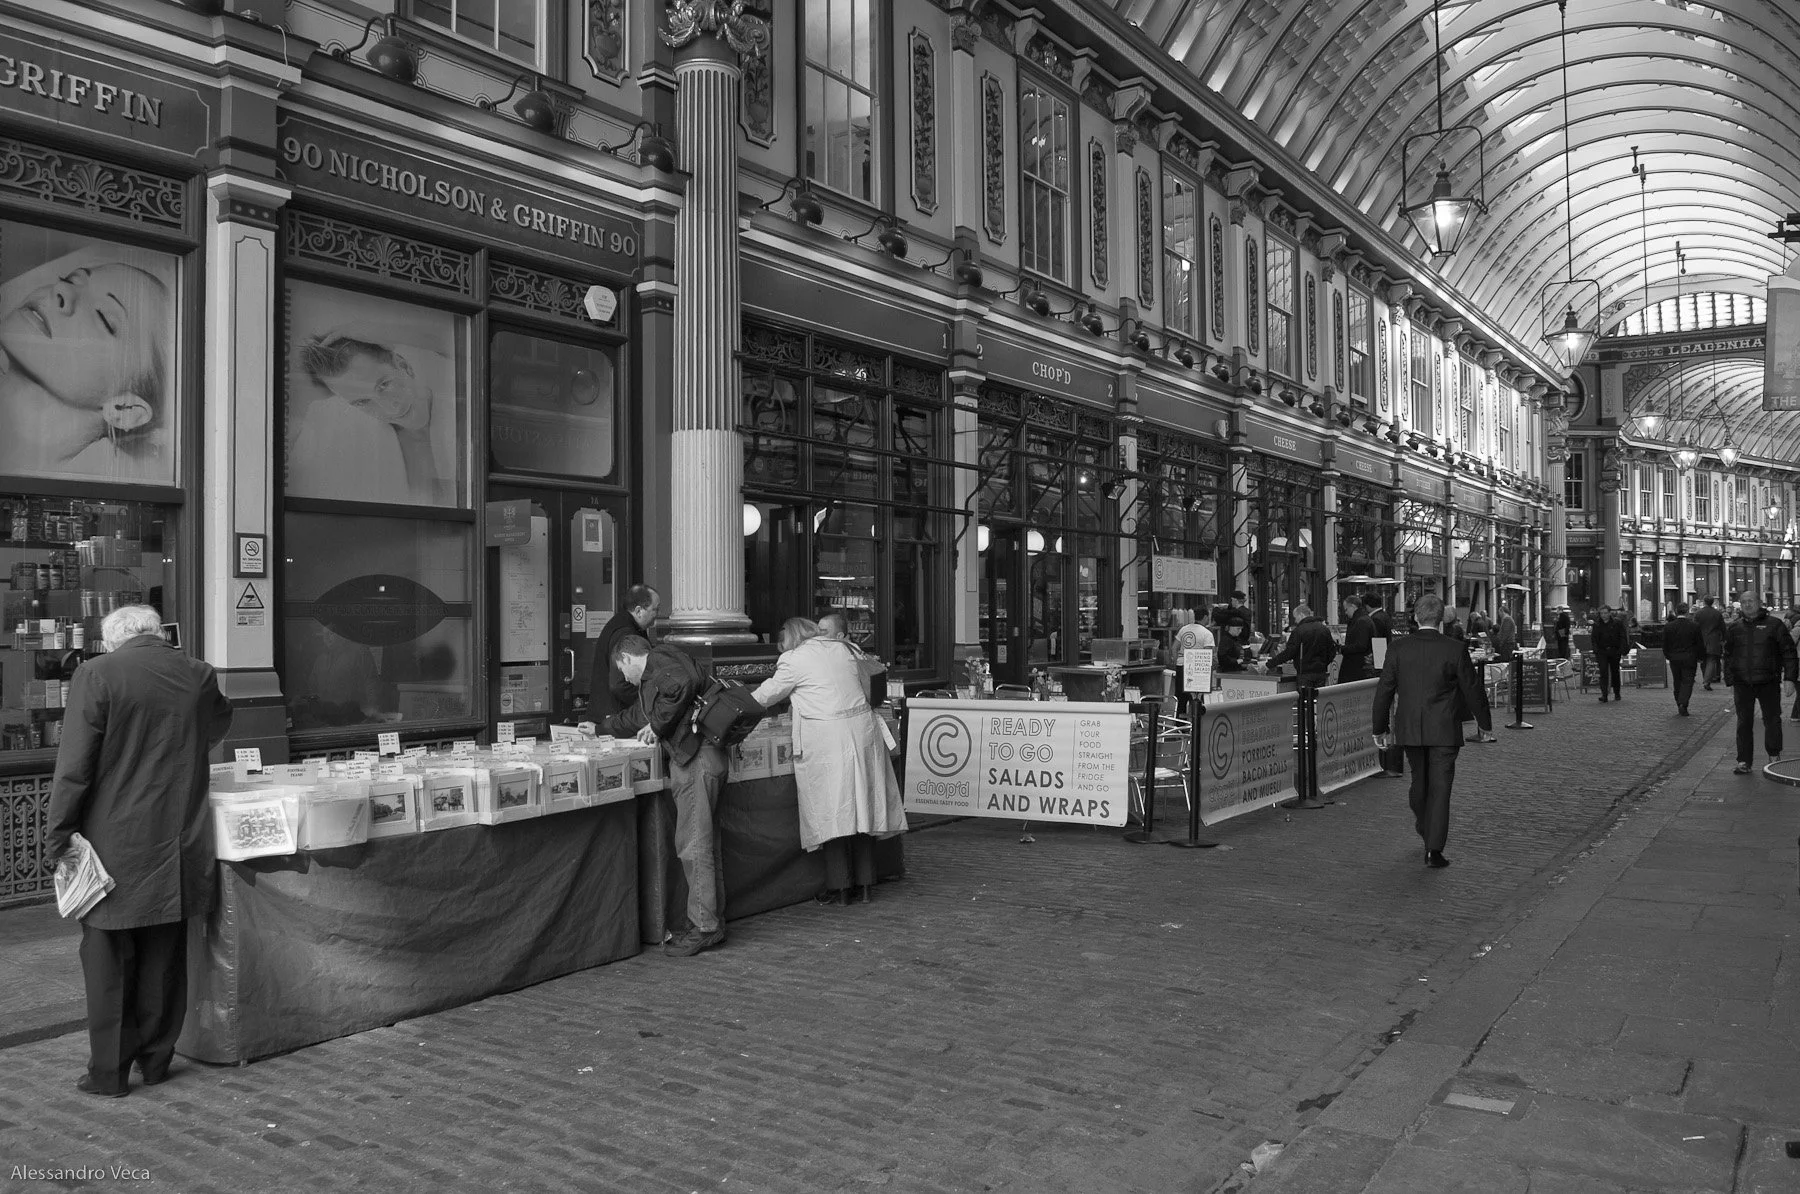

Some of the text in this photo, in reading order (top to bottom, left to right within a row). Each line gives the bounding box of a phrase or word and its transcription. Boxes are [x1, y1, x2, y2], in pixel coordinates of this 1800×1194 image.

[0, 54, 163, 127] GRIFFIN
[283, 135, 636, 258] 90 NICHOLSON & GRIFFIN 90
[1032, 360, 1073, 386] CHOP'D
[1770, 395, 1798, 408] THE
[1273, 435, 1297, 452] CHEESE
[990, 716, 1057, 738] READY
[1079, 719, 1102, 728] GRAB
[1079, 730, 1101, 738] YOUR
[988, 741, 1054, 763] TO GO
[1079, 740, 1102, 749] FOOD
[1343, 736, 1365, 757] SALADS
[1077, 751, 1114, 760] STRAIGHT
[1344, 760, 1356, 777] AND
[1357, 752, 1376, 773] WRAPS
[1077, 762, 1115, 772] FROM THE
[1077, 772, 1105, 782] FRIDGE
[1242, 759, 1288, 784] BACON ROLLS
[916, 779, 970, 799] chop'd
[987, 767, 1065, 790] SALADS
[1077, 783, 1110, 793] AND GO
[1242, 787, 1258, 803] AND
[1259, 780, 1282, 798] MUESLI
[986, 792, 1110, 819] AND WRAPS
